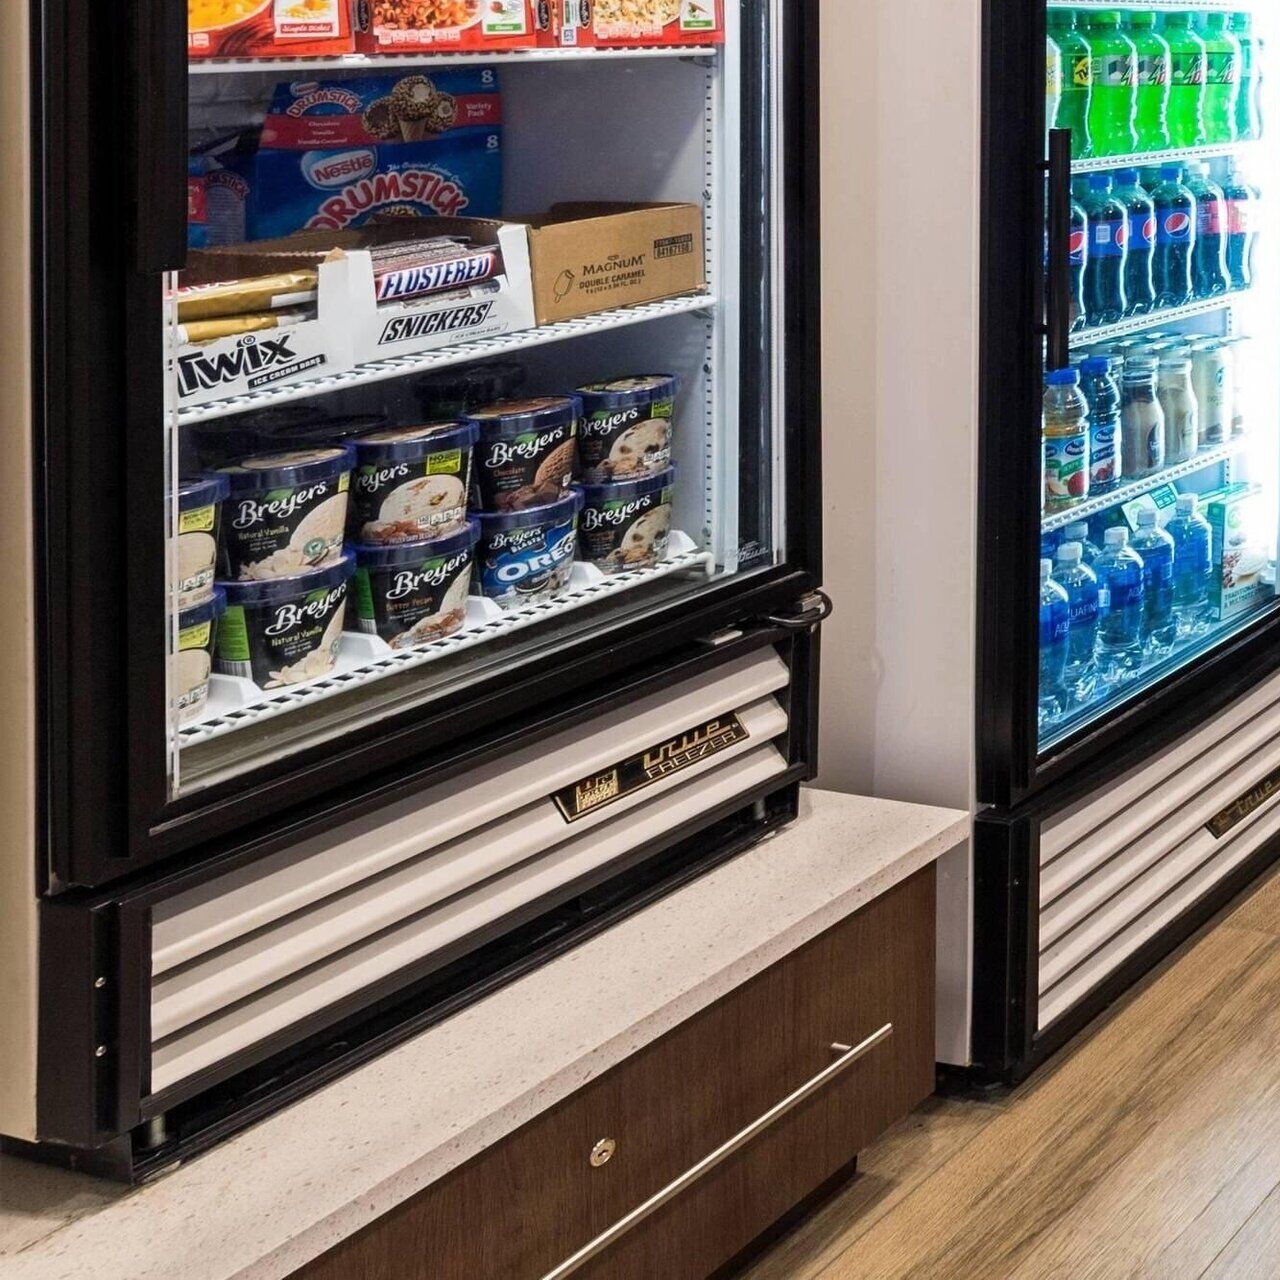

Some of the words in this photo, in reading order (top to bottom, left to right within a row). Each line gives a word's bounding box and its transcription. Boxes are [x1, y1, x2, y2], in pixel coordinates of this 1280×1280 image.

[481, 70, 493, 83] 8
[286, 88, 362, 117] DRUMSTICK
[465, 102, 492, 111] Variety
[467, 109, 485, 118] Pack
[486, 135, 498, 149] 8
[303, 172, 468, 231] DRUMSTICK
[381, 255, 491, 299] FLUSTERED
[579, 276, 609, 290] DOUBLE
[611, 270, 646, 283] CARAMEL
[582, 255, 645, 276] MAGNUM
[383, 302, 490, 342] SNICKERS
[252, 373, 268, 387] ICE
[268, 365, 297, 382] CREAM
[299, 356, 322, 371] BARS
[580, 407, 639, 436] Breyers
[485, 426, 564, 468] Breyers
[356, 461, 410, 493] reyers
[232, 481, 326, 529] Breyers
[581, 494, 651, 532] Breyers
[238, 528, 263, 541] Natural
[263, 525, 290, 538] Vanilla
[489, 527, 542, 550] Breyers
[386, 548, 469, 600] Breyers
[496, 540, 574, 583] OREO
[265, 581, 347, 635] Breyers
[271, 632, 300, 648] Natural
[300, 625, 323, 641] Vanilla
[645, 730, 738, 779] FREEZER
